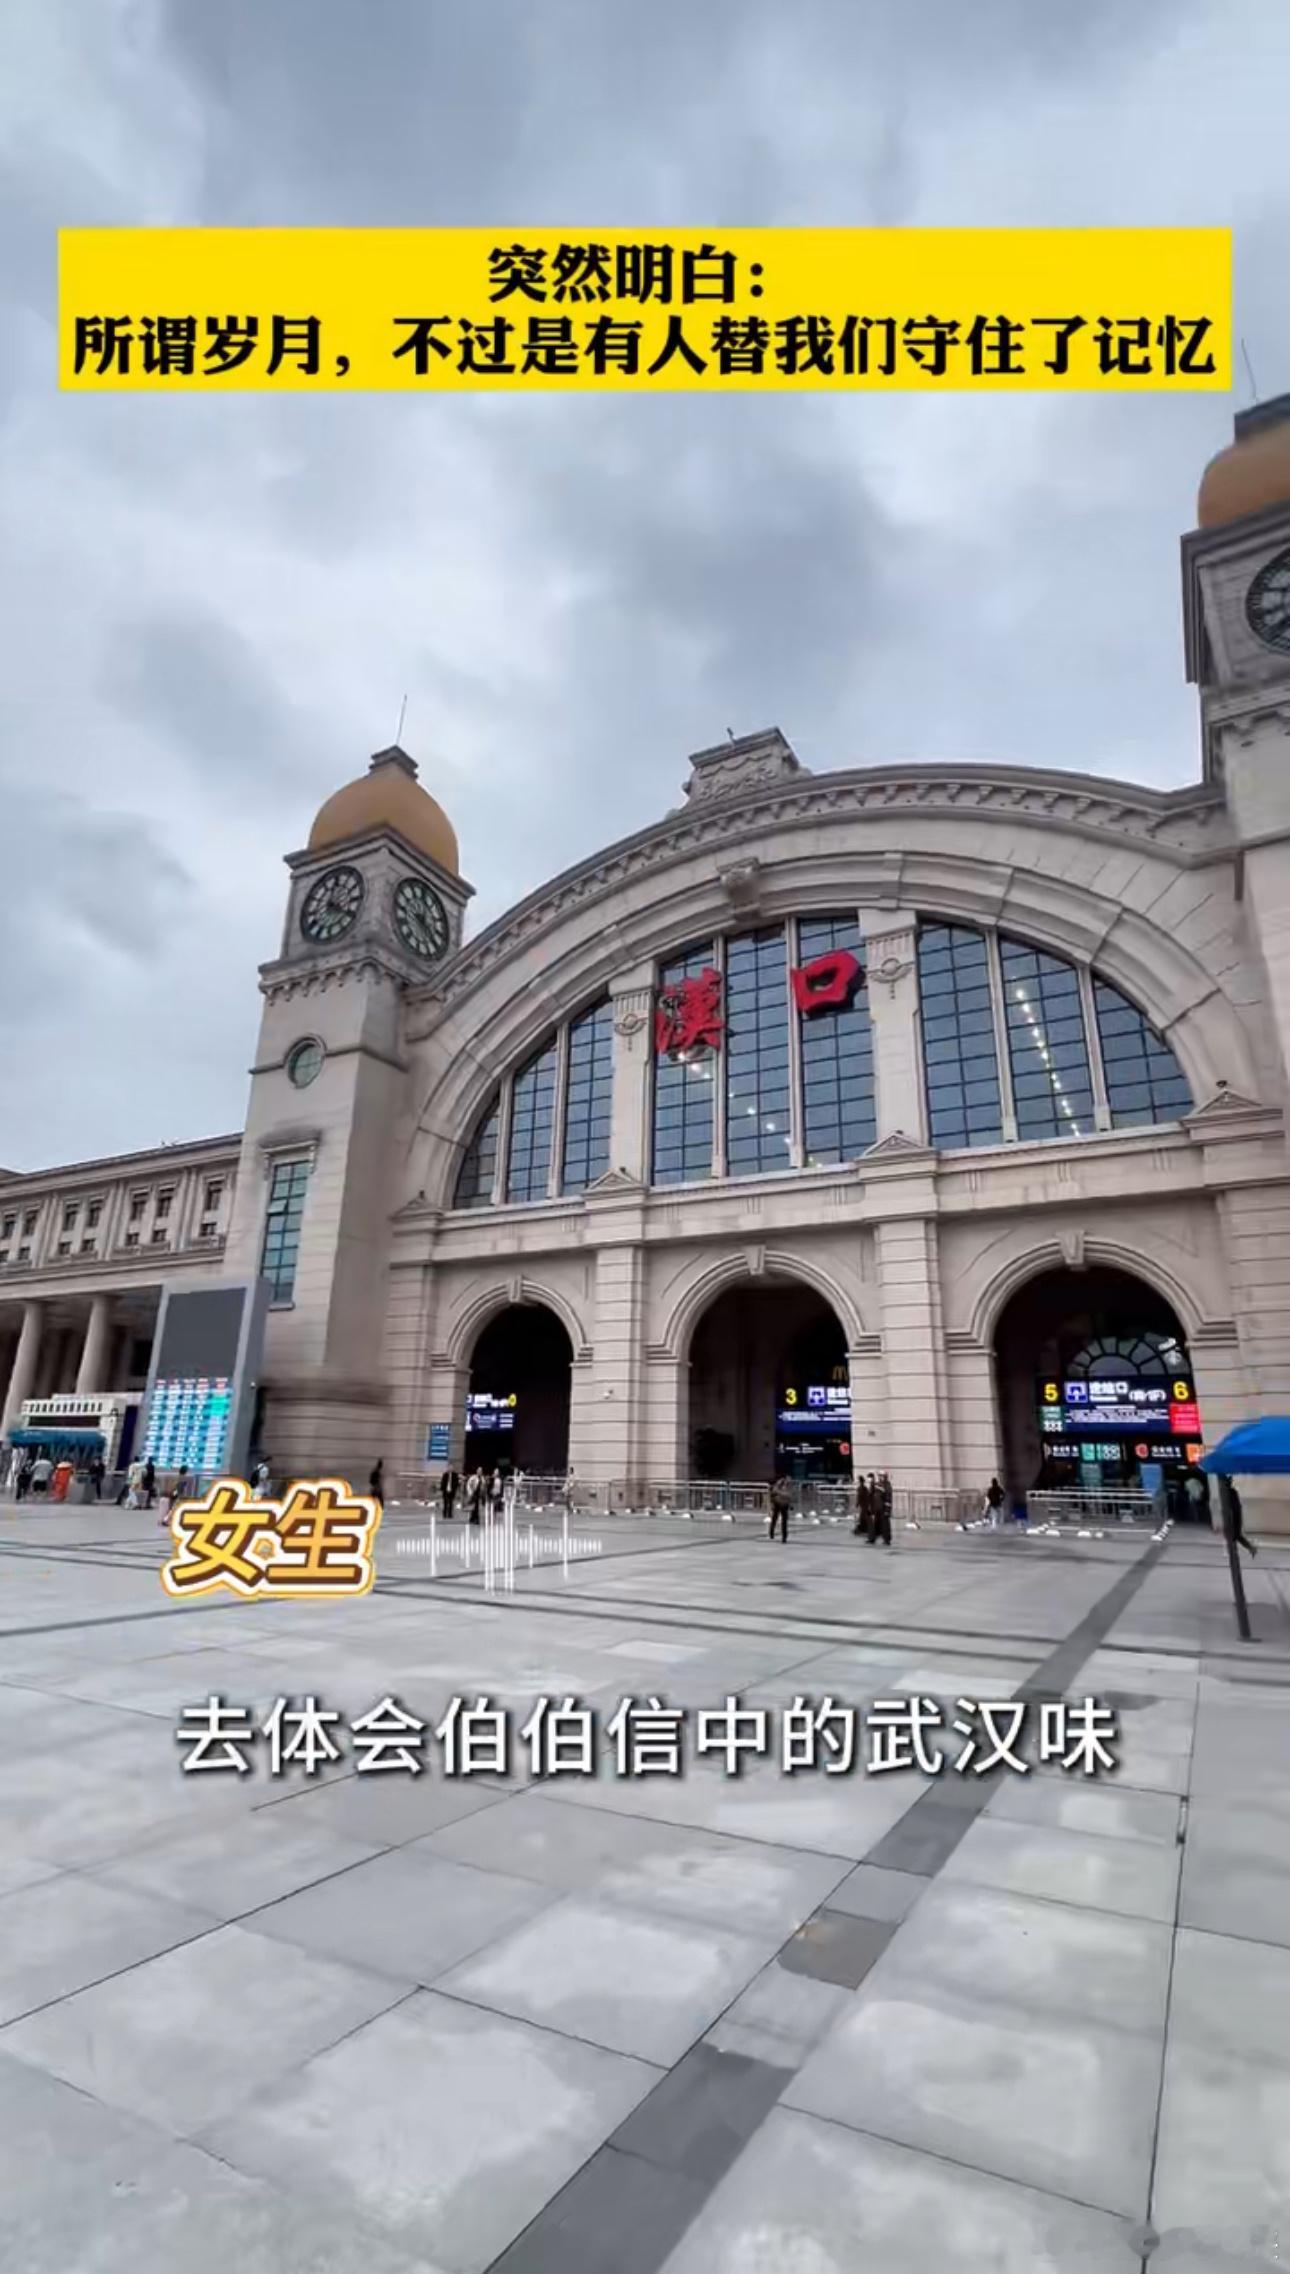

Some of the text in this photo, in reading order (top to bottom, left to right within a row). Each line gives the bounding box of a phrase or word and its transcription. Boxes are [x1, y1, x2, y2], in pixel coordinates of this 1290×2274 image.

[785, 1388, 797, 1405] 3
[1044, 1383, 1058, 1401] 5
[1173, 1381, 1189, 1400] 6
